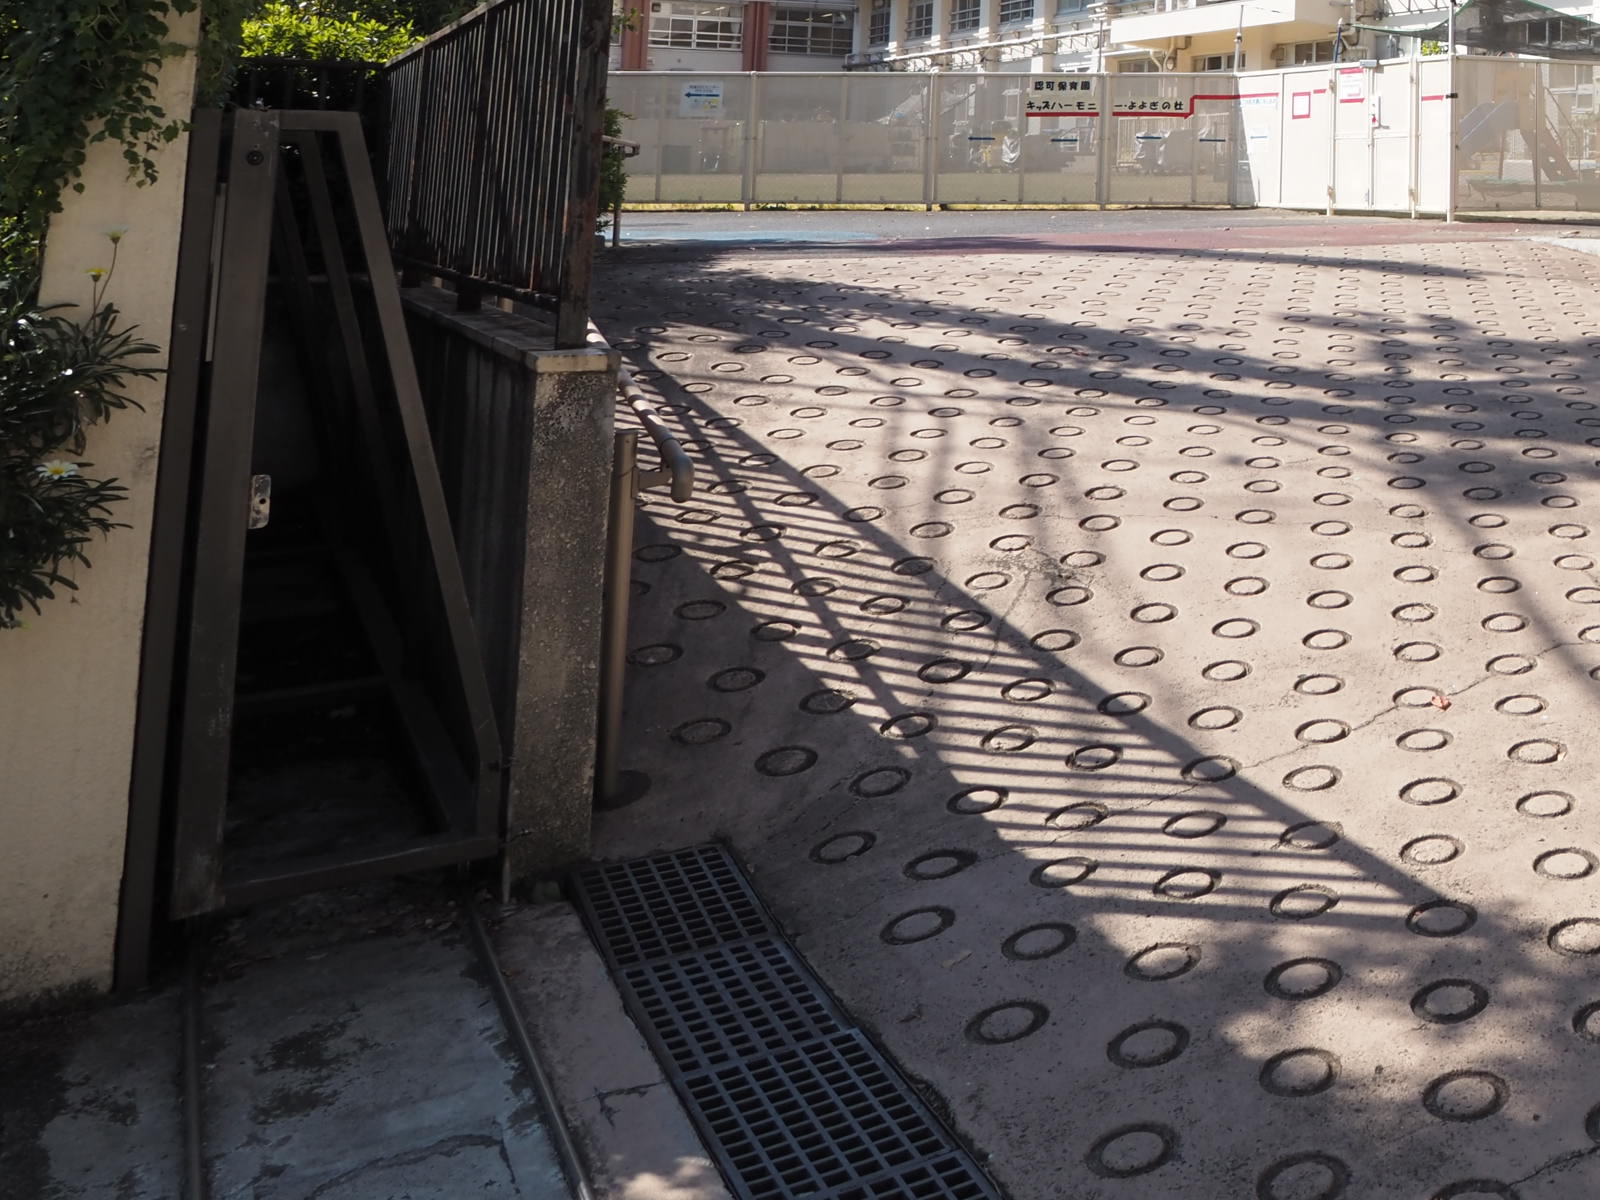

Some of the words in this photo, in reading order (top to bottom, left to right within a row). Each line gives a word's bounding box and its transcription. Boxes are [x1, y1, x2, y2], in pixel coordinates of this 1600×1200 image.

[1034, 81, 1091, 91] 認可保育園
